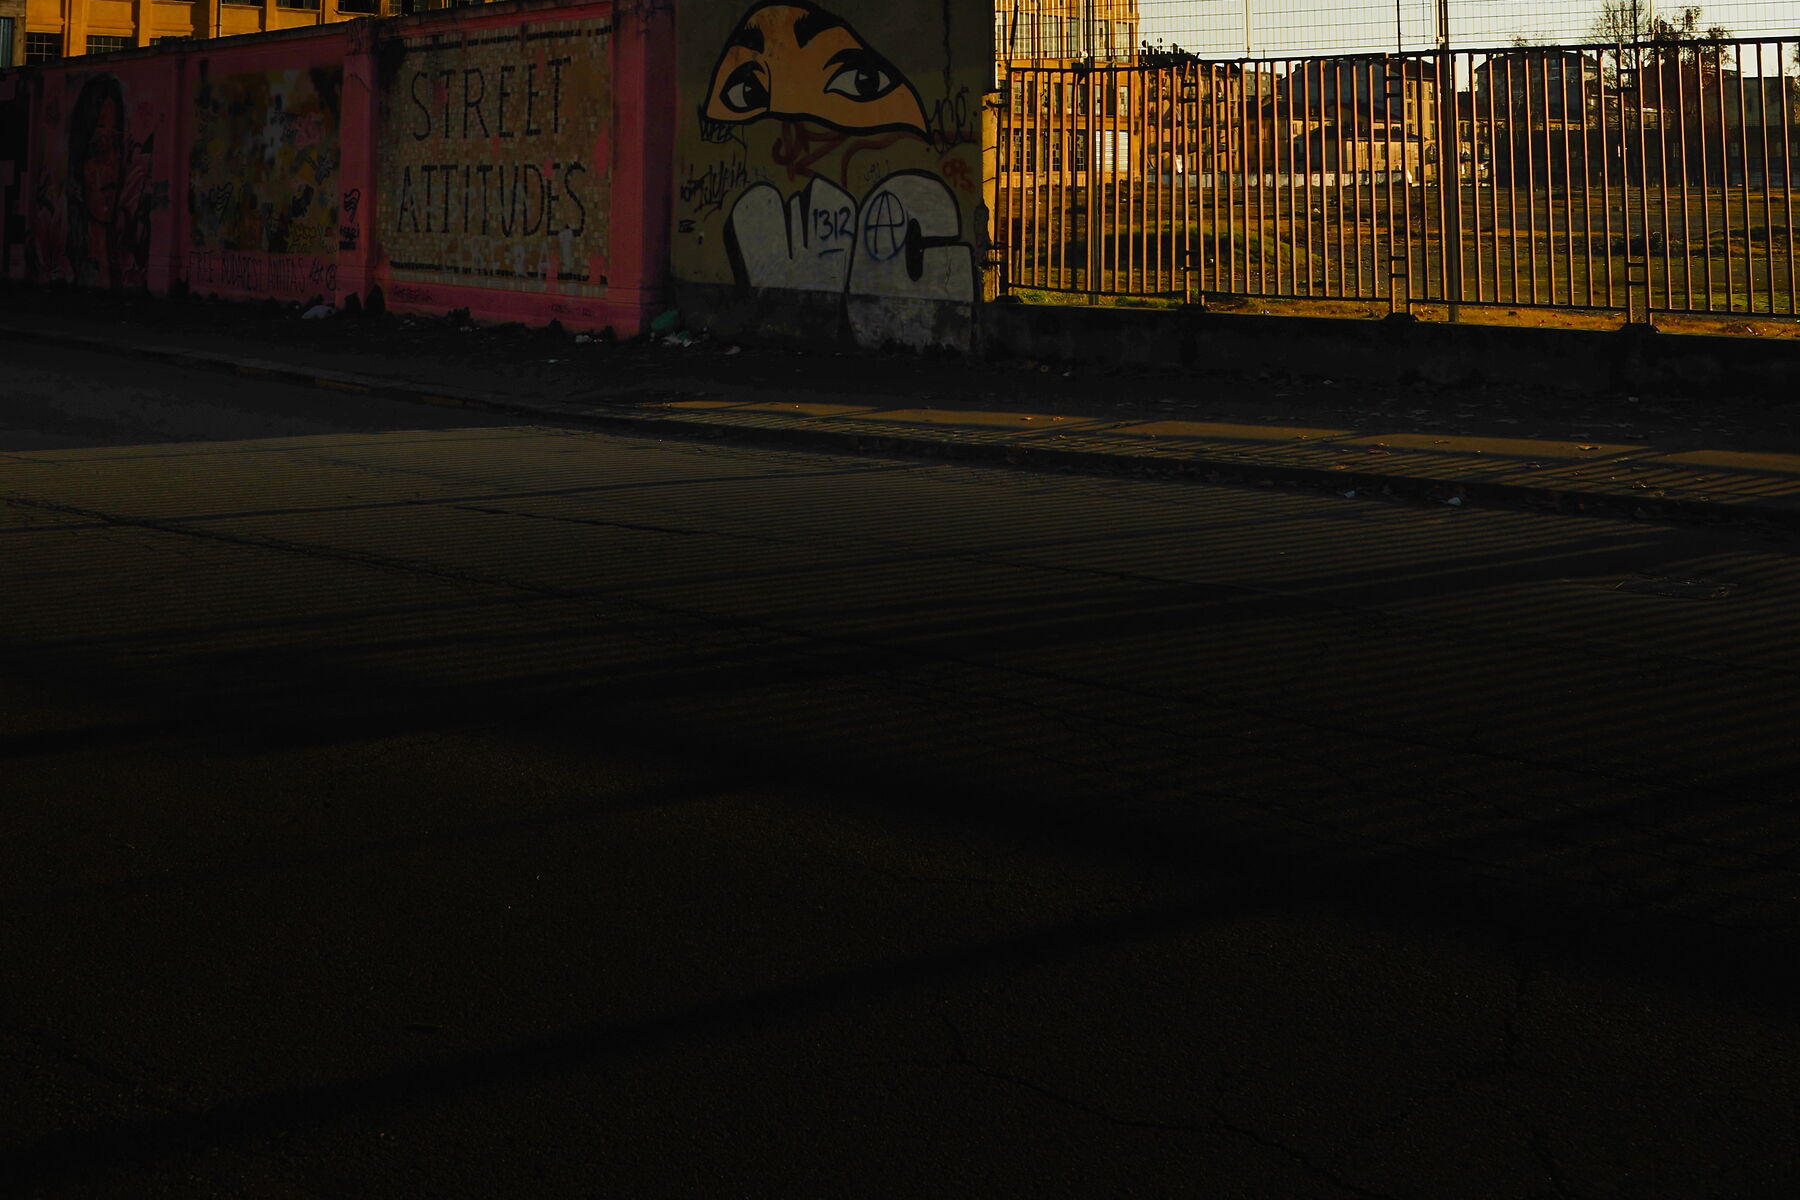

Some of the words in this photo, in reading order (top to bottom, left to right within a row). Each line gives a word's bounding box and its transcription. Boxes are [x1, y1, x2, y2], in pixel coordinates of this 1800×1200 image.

[411, 56, 572, 141] STREET
[396, 160, 587, 238] ATTITUDES
[812, 205, 855, 241] 1312
